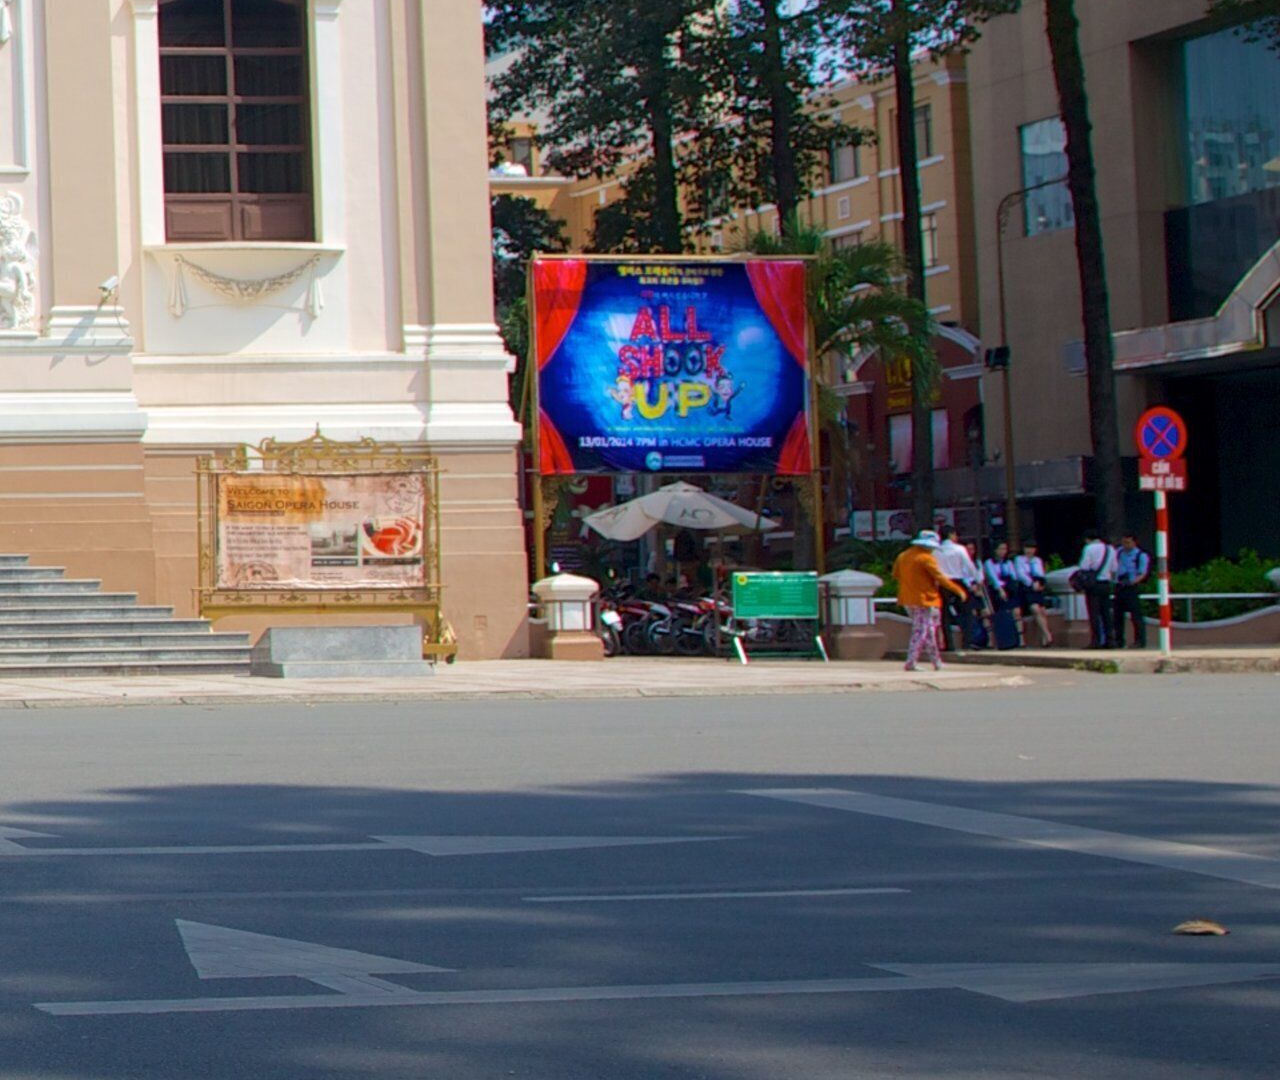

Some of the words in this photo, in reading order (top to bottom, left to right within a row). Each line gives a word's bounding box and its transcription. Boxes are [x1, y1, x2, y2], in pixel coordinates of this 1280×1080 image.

[628, 305, 711, 343] ALL
[618, 342, 727, 380] SHOOK
[634, 381, 711, 419] UP
[738, 436, 772, 447] HOUSE
[227, 499, 271, 510] SAIGON
[275, 499, 315, 510] OPERA
[321, 499, 359, 510] HOUSE
